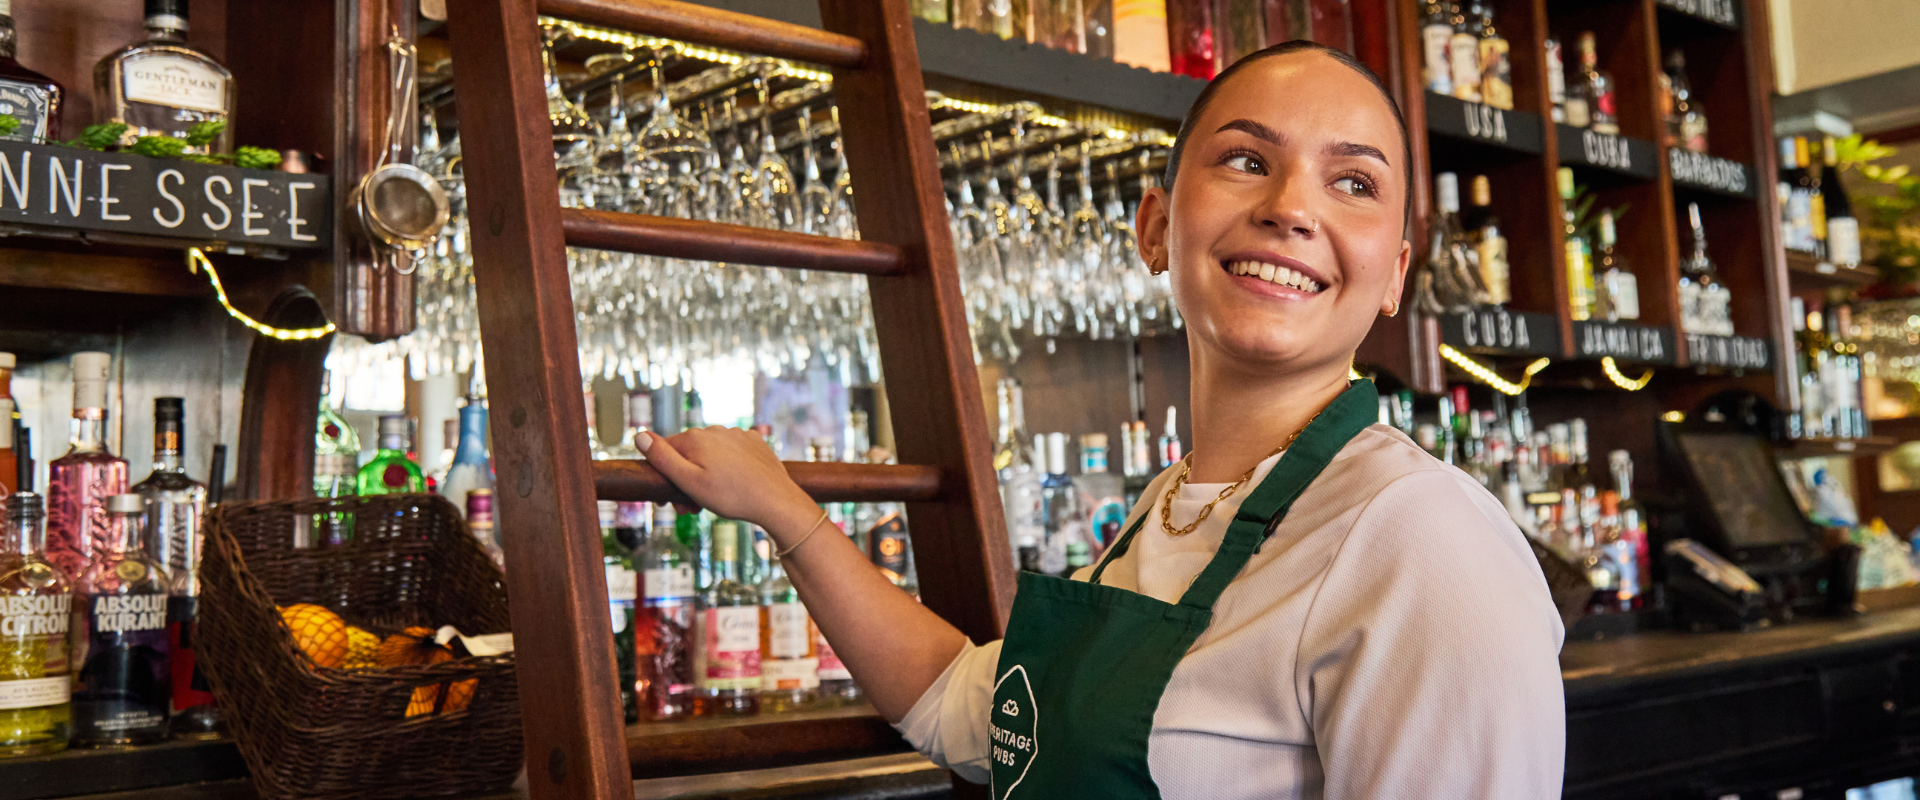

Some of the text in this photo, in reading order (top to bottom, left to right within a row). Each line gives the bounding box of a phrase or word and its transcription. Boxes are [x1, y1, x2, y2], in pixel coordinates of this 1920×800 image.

[135, 71, 217, 90] GENTLEMAN
[161, 84, 191, 97] JACK
[1463, 101, 1507, 143] USA
[1583, 129, 1631, 170] CUBA
[0, 150, 317, 242] NNESSEE
[1462, 309, 1530, 349] CUBA
[1582, 322, 1664, 360] JAMAICA
[0, 594, 72, 615] ABSOLUT
[95, 594, 168, 615] ABSOLUT
[1, 613, 69, 636] CITRON
[98, 611, 167, 633] KURANT
[993, 745, 1015, 766] PUBS
